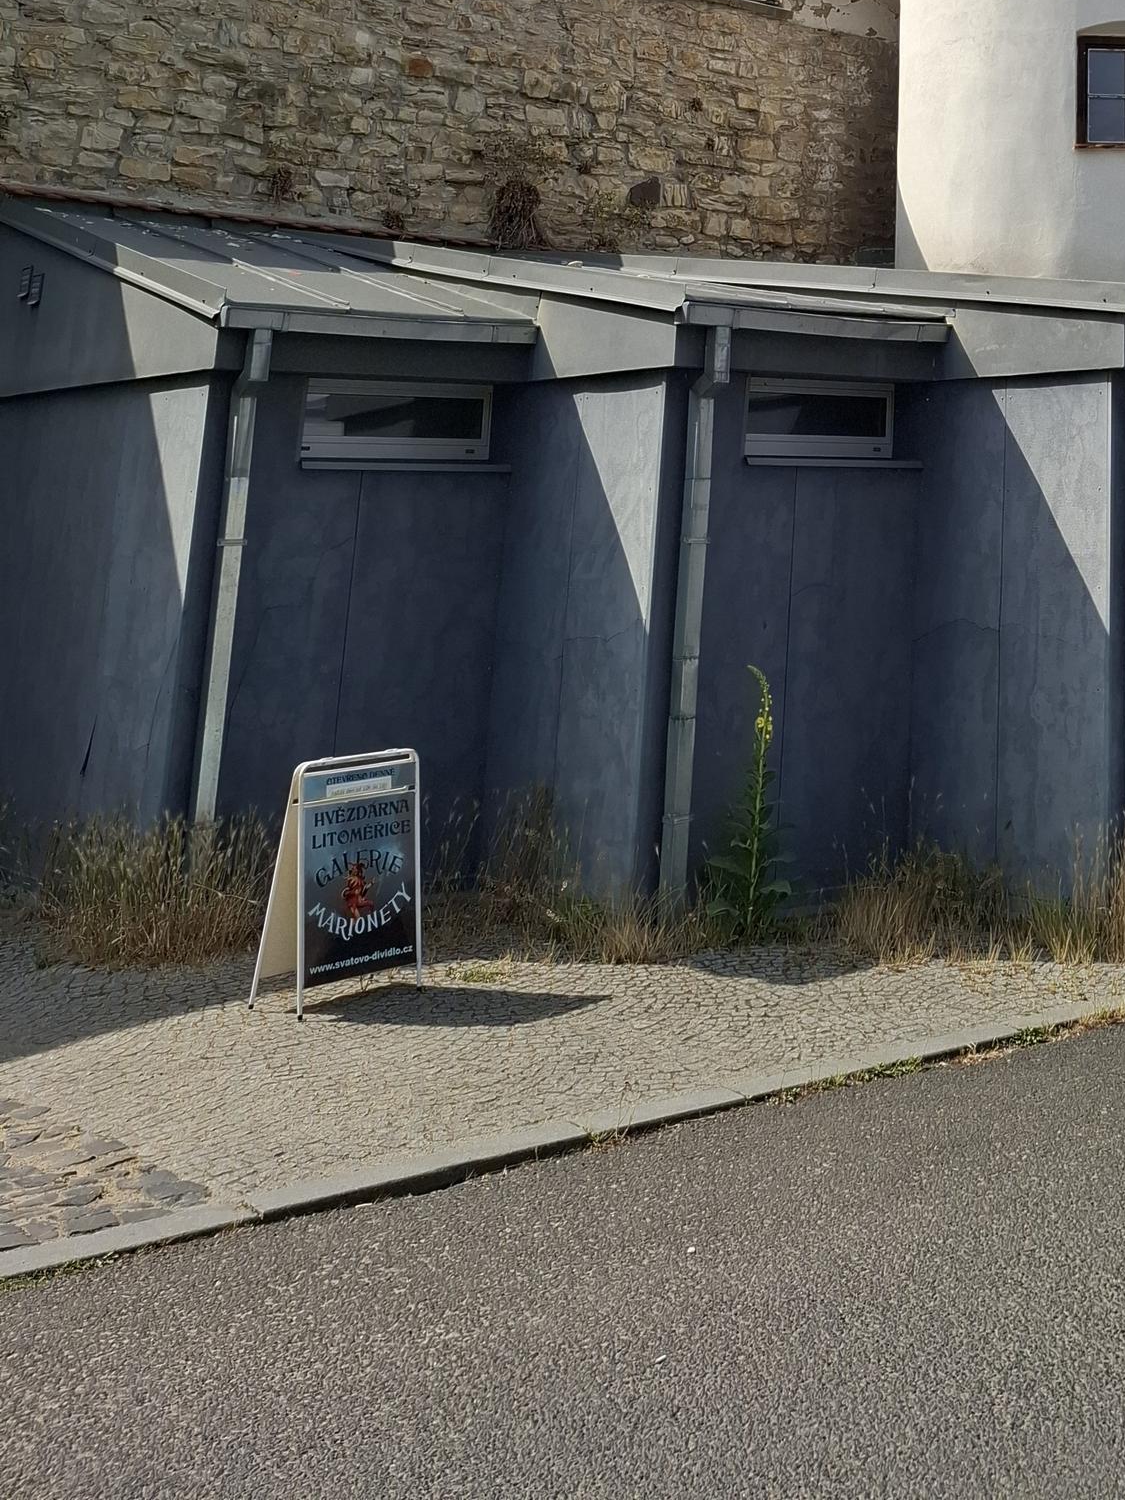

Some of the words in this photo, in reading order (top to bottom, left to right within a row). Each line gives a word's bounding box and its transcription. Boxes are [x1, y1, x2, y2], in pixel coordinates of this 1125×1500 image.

[315, 849, 404, 888] GALERIE
[308, 881, 411, 940] MARIONETY
[309, 945, 413, 974] www.svatovo-dividlo.cz
